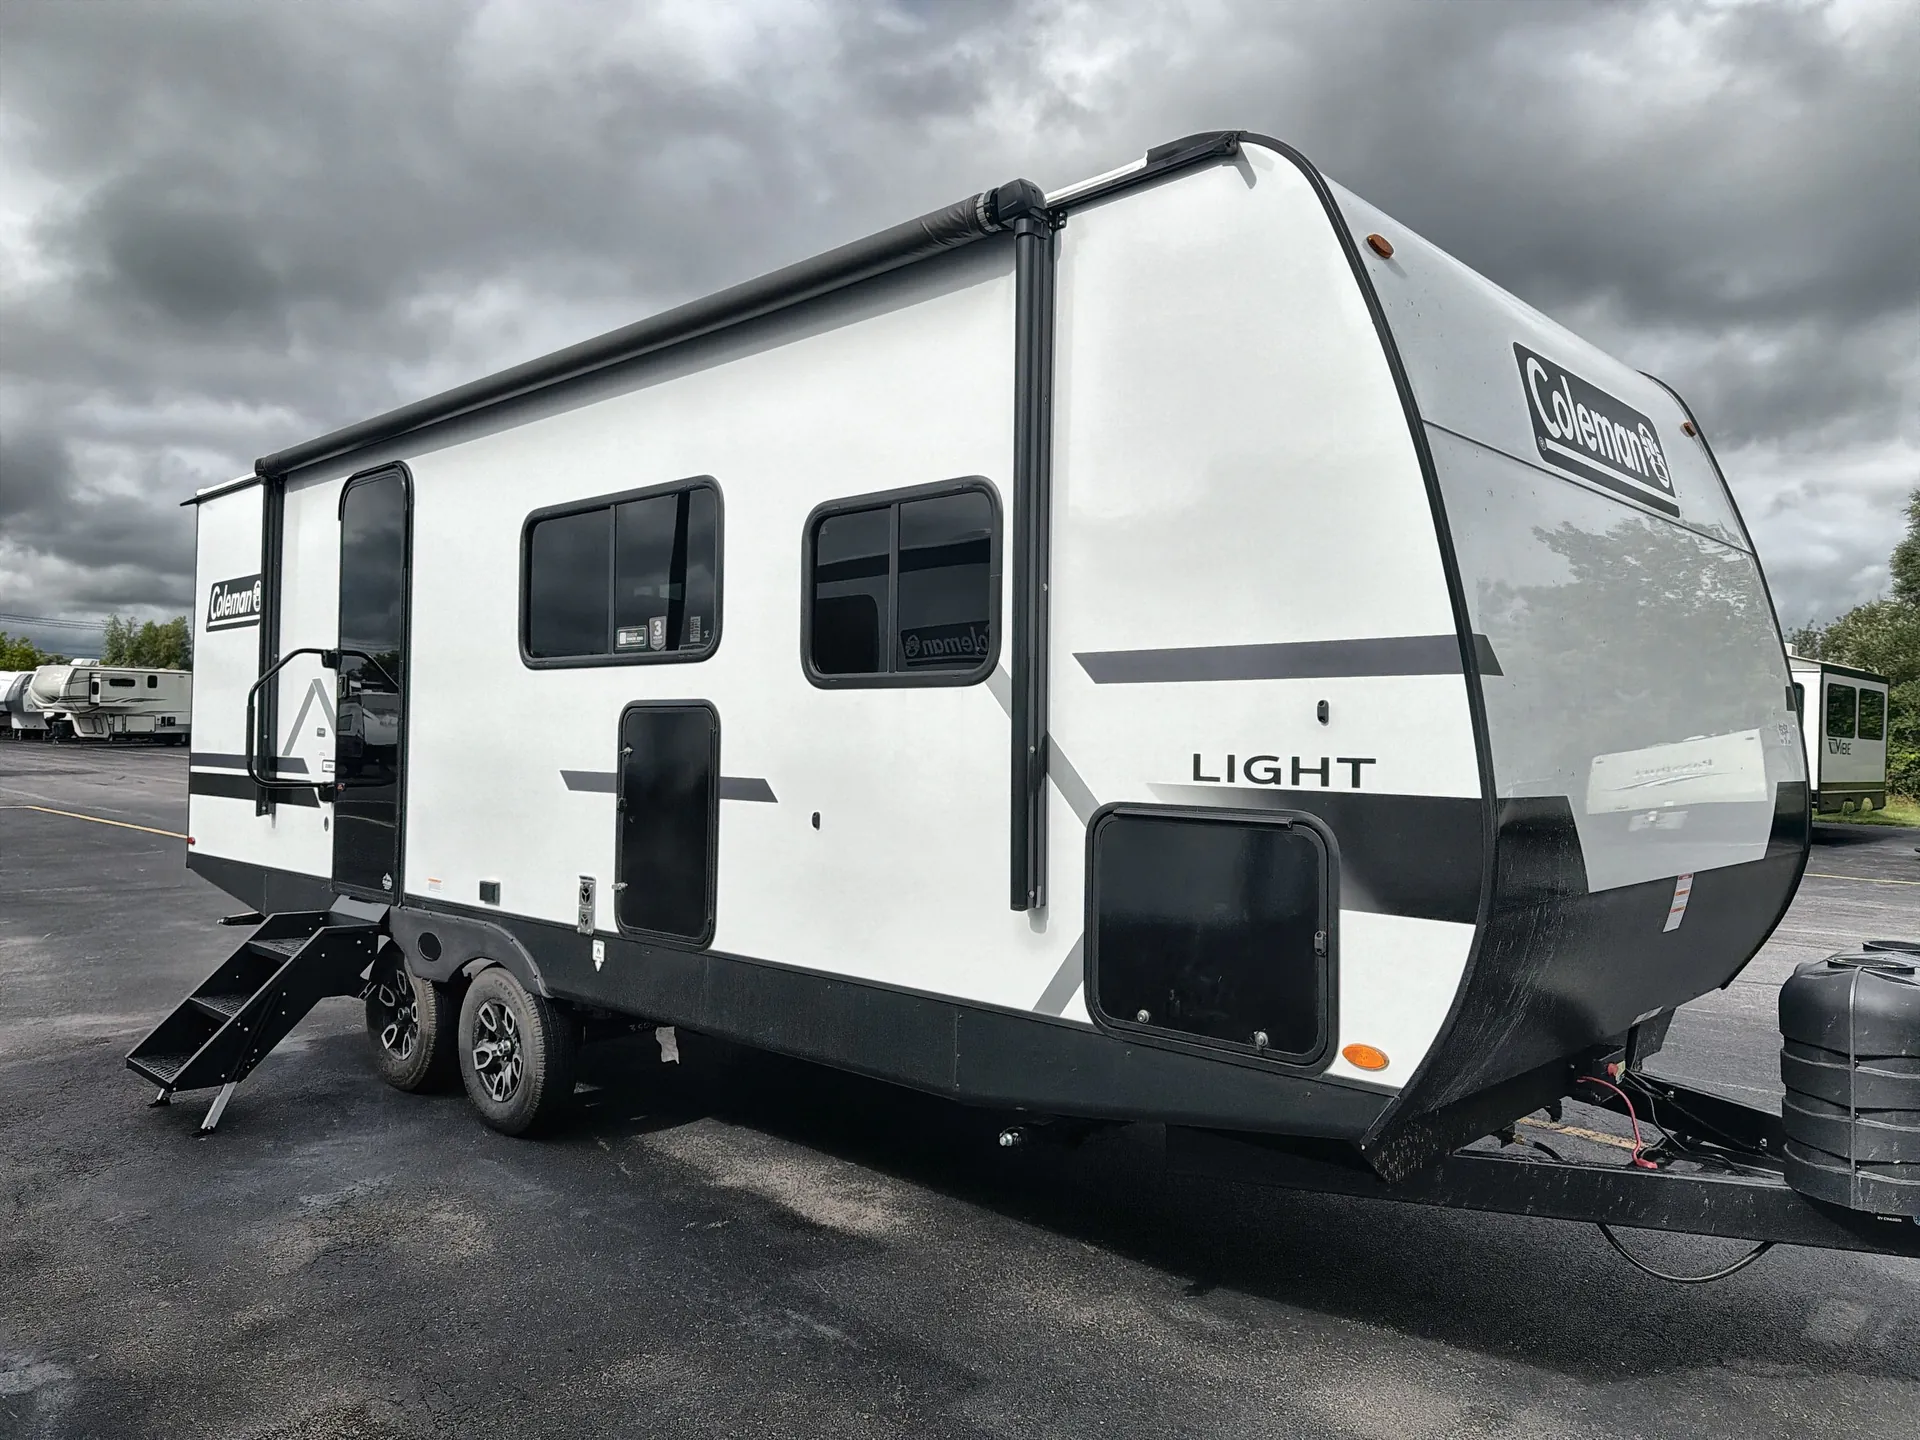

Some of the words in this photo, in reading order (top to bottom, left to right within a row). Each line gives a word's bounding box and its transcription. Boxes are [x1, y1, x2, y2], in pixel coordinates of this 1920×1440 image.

[1526, 357, 1650, 478] Coleman
[211, 584, 253, 620] Coleman
[654, 620, 663, 636] 3
[1193, 753, 1376, 788] LIGHT
